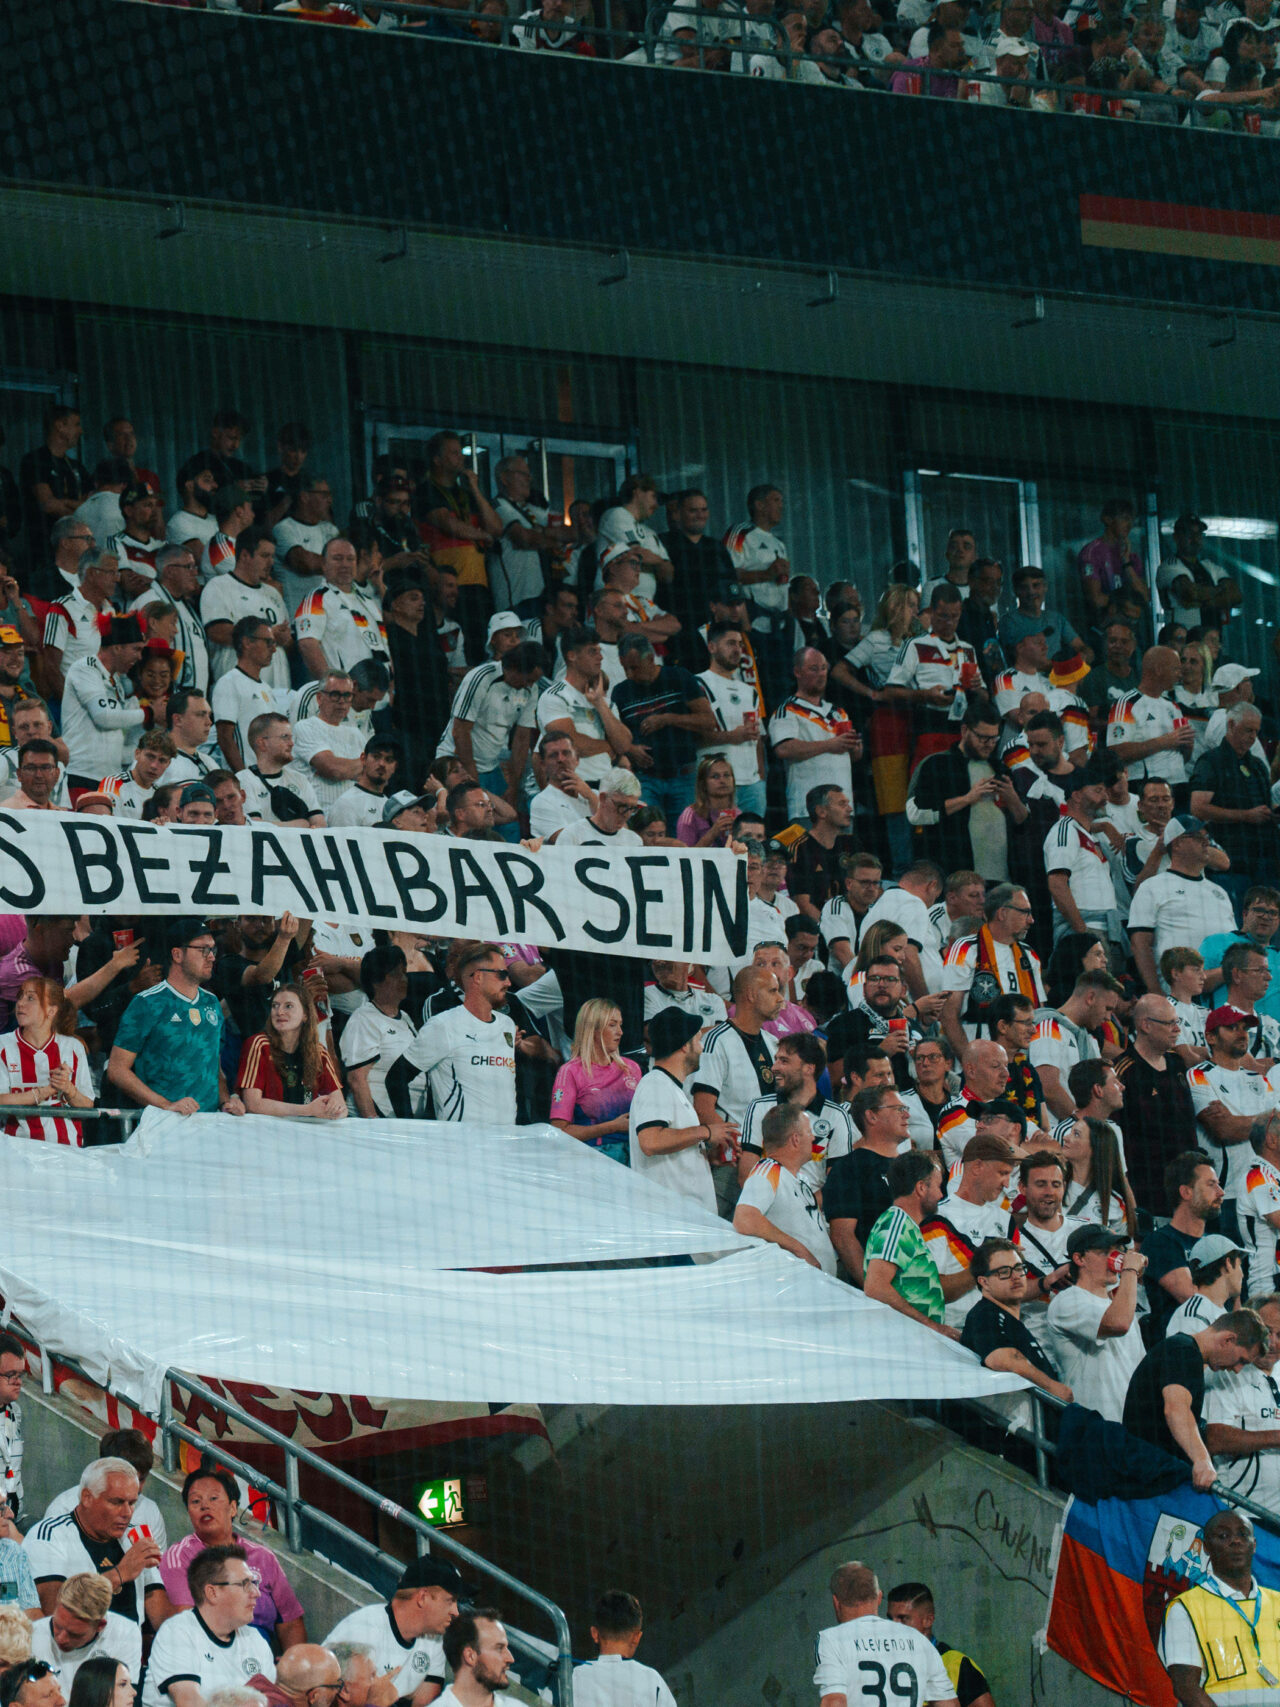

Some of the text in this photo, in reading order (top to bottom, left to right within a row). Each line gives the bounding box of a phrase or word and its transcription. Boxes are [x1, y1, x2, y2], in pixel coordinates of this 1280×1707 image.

[60, 821, 566, 942] BEZAHLBAR
[574, 855, 748, 958] SEIN
[858, 1661, 919, 1706] 39
